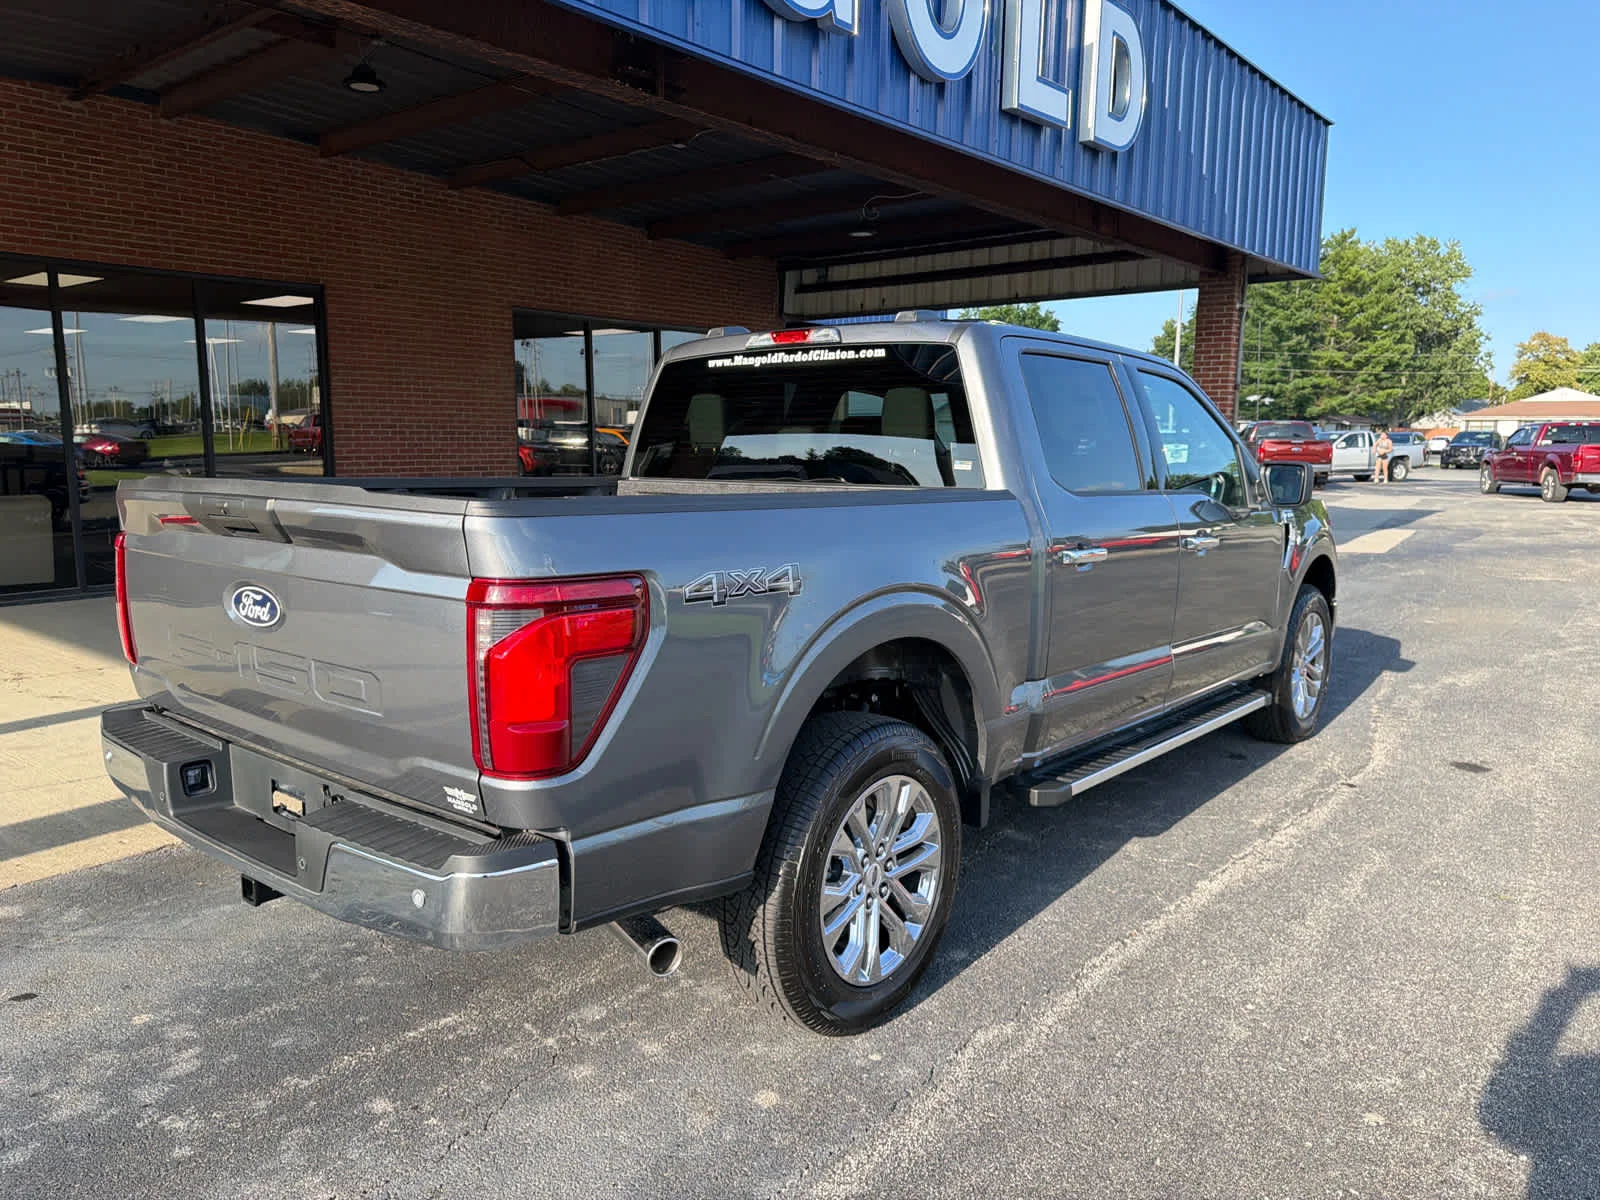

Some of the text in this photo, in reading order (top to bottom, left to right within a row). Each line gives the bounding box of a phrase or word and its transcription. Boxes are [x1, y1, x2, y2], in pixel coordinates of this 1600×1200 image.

[762, 0, 1147, 152] LD
[707, 347, 886, 368] www.MangoldFordofClinton.com
[238, 589, 271, 622] Ford
